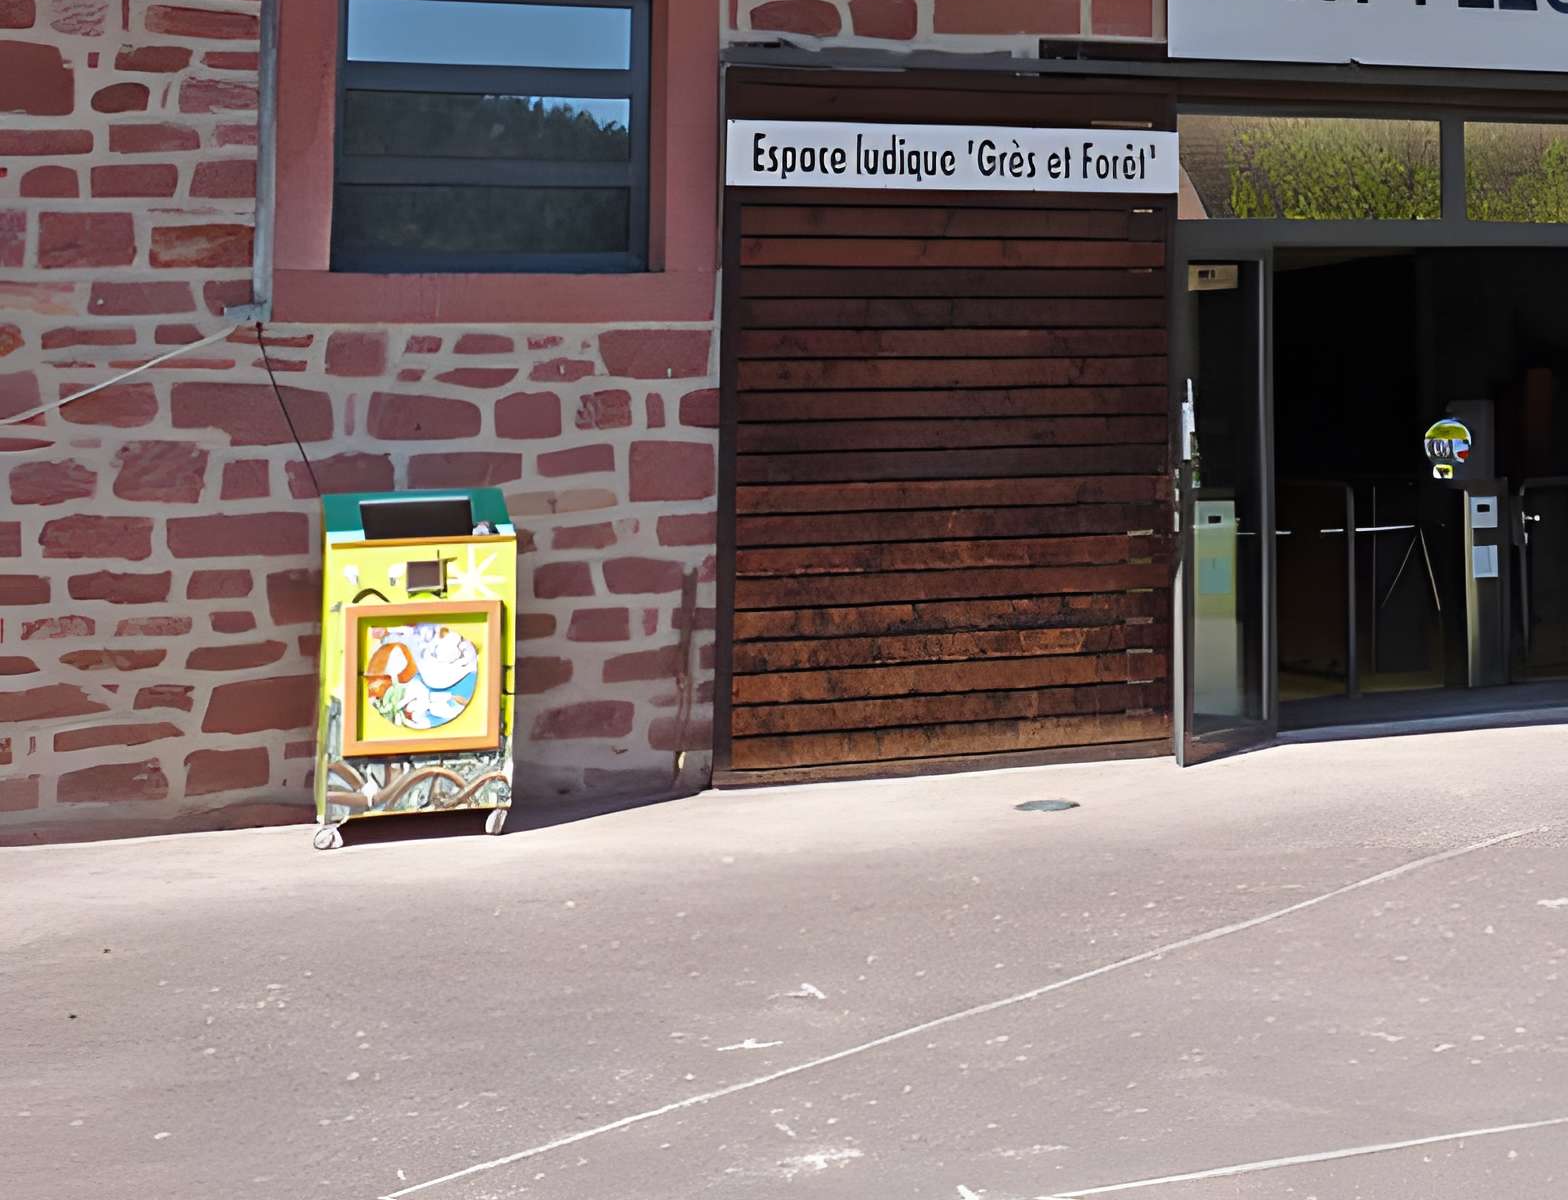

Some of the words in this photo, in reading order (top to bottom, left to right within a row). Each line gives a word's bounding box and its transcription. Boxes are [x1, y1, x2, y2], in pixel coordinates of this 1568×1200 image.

[752, 132, 847, 180] Espace
[856, 133, 956, 182] ludique
[1047, 146, 1072, 180] et
